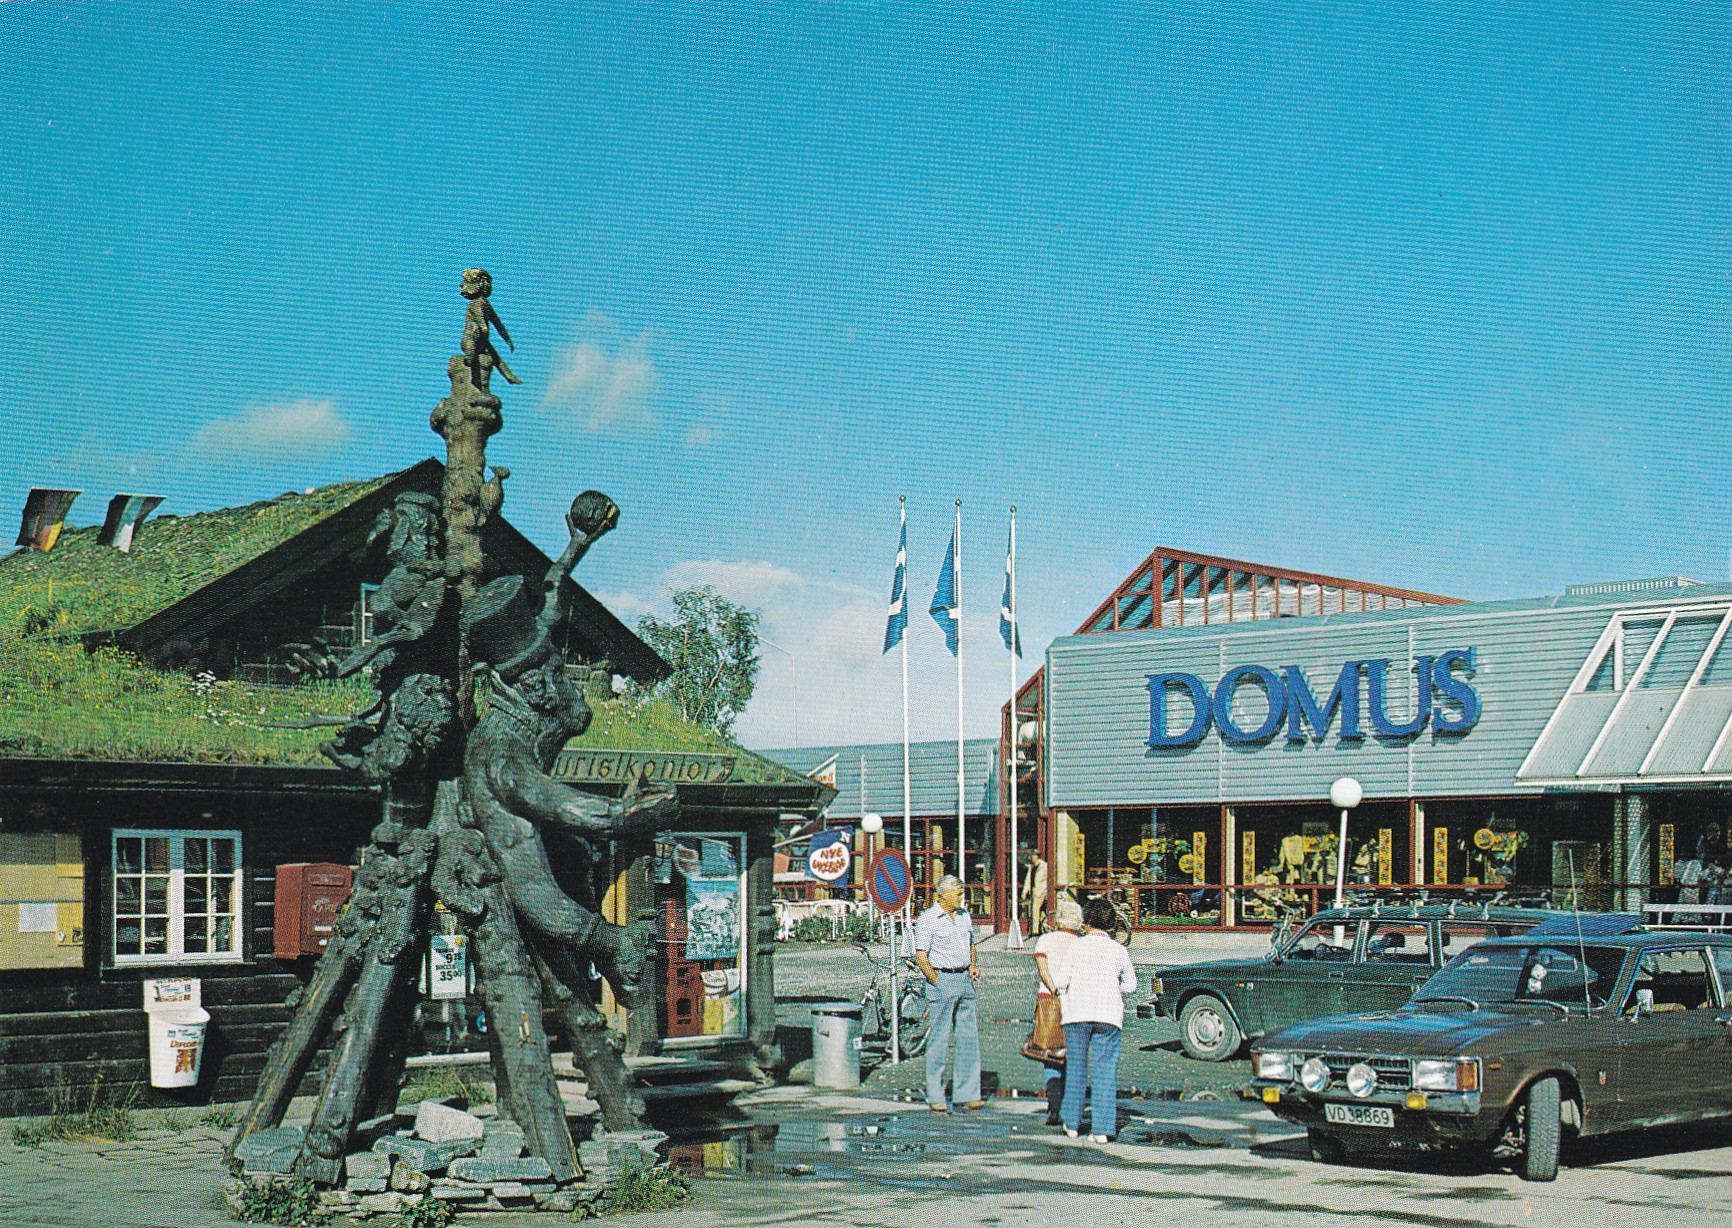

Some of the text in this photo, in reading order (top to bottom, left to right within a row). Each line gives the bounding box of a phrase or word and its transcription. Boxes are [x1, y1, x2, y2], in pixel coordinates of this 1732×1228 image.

[1144, 647, 1482, 747] DOMUS
[553, 752, 717, 782] uristkontor
[820, 847, 844, 860] NYE
